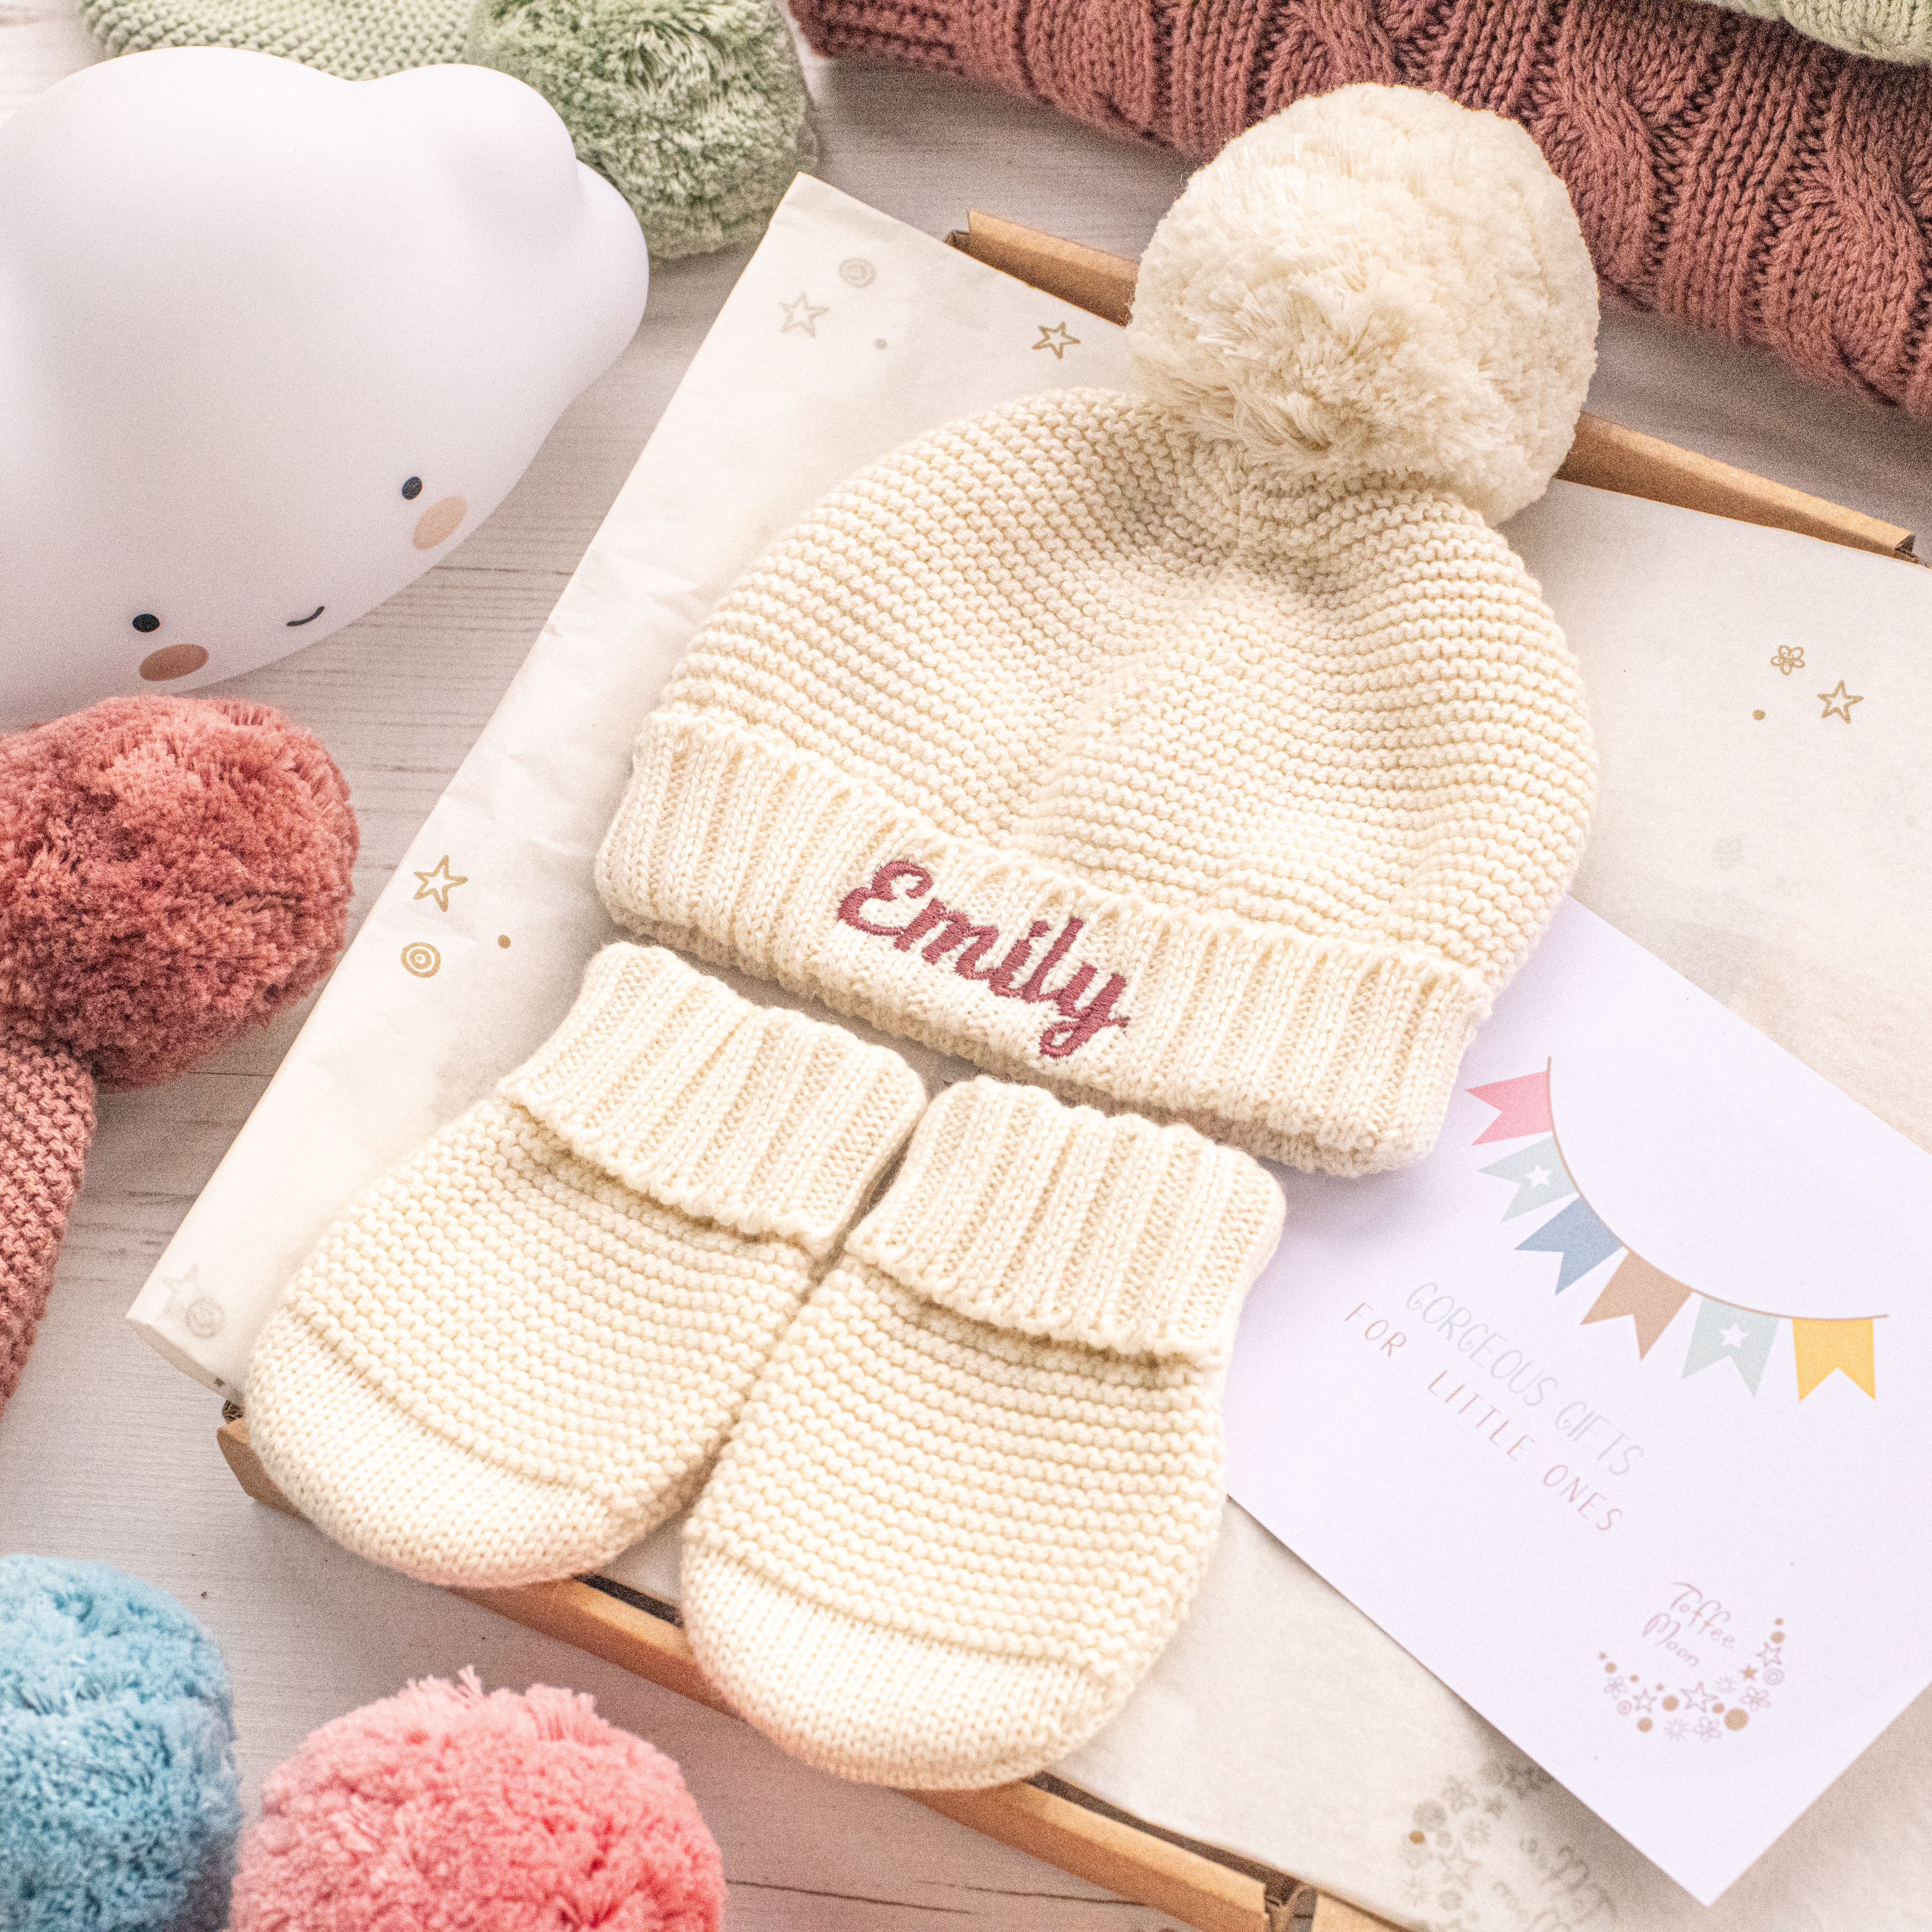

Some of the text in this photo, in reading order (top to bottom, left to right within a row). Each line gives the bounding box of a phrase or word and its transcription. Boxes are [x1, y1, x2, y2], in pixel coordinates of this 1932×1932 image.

[837, 860, 1130, 1059] Emily
[1344, 1302, 1623, 1531] FOR LITTLE ONES
[1406, 1282, 1644, 1476] GORGEOUS GIFTS
[1642, 1612, 1700, 1668] Moon
[1670, 1581, 1735, 1649] Toffee
